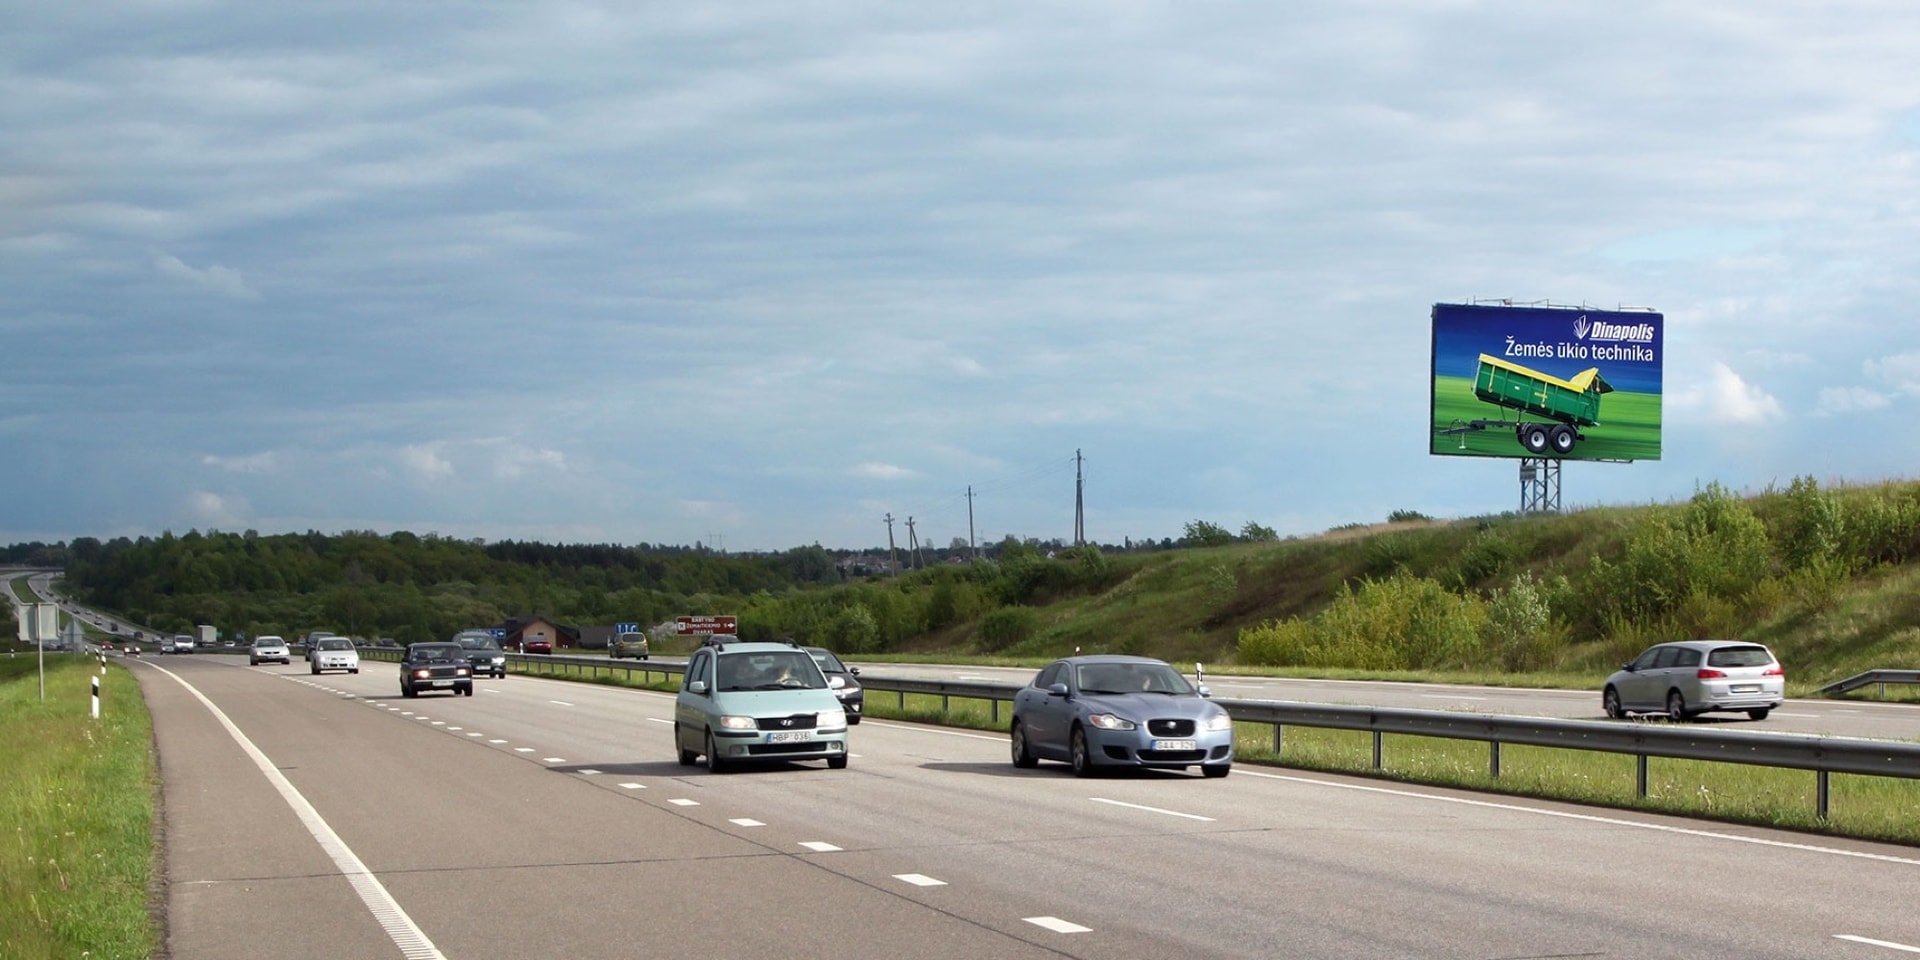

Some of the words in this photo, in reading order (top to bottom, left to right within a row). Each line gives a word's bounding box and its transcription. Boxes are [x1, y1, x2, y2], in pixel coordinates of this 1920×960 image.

[1591, 321, 1654, 342] Dinapolis
[1505, 335, 1554, 357] Žemės
[1558, 342, 1588, 359] ūkio
[1592, 344, 1653, 362] technika
